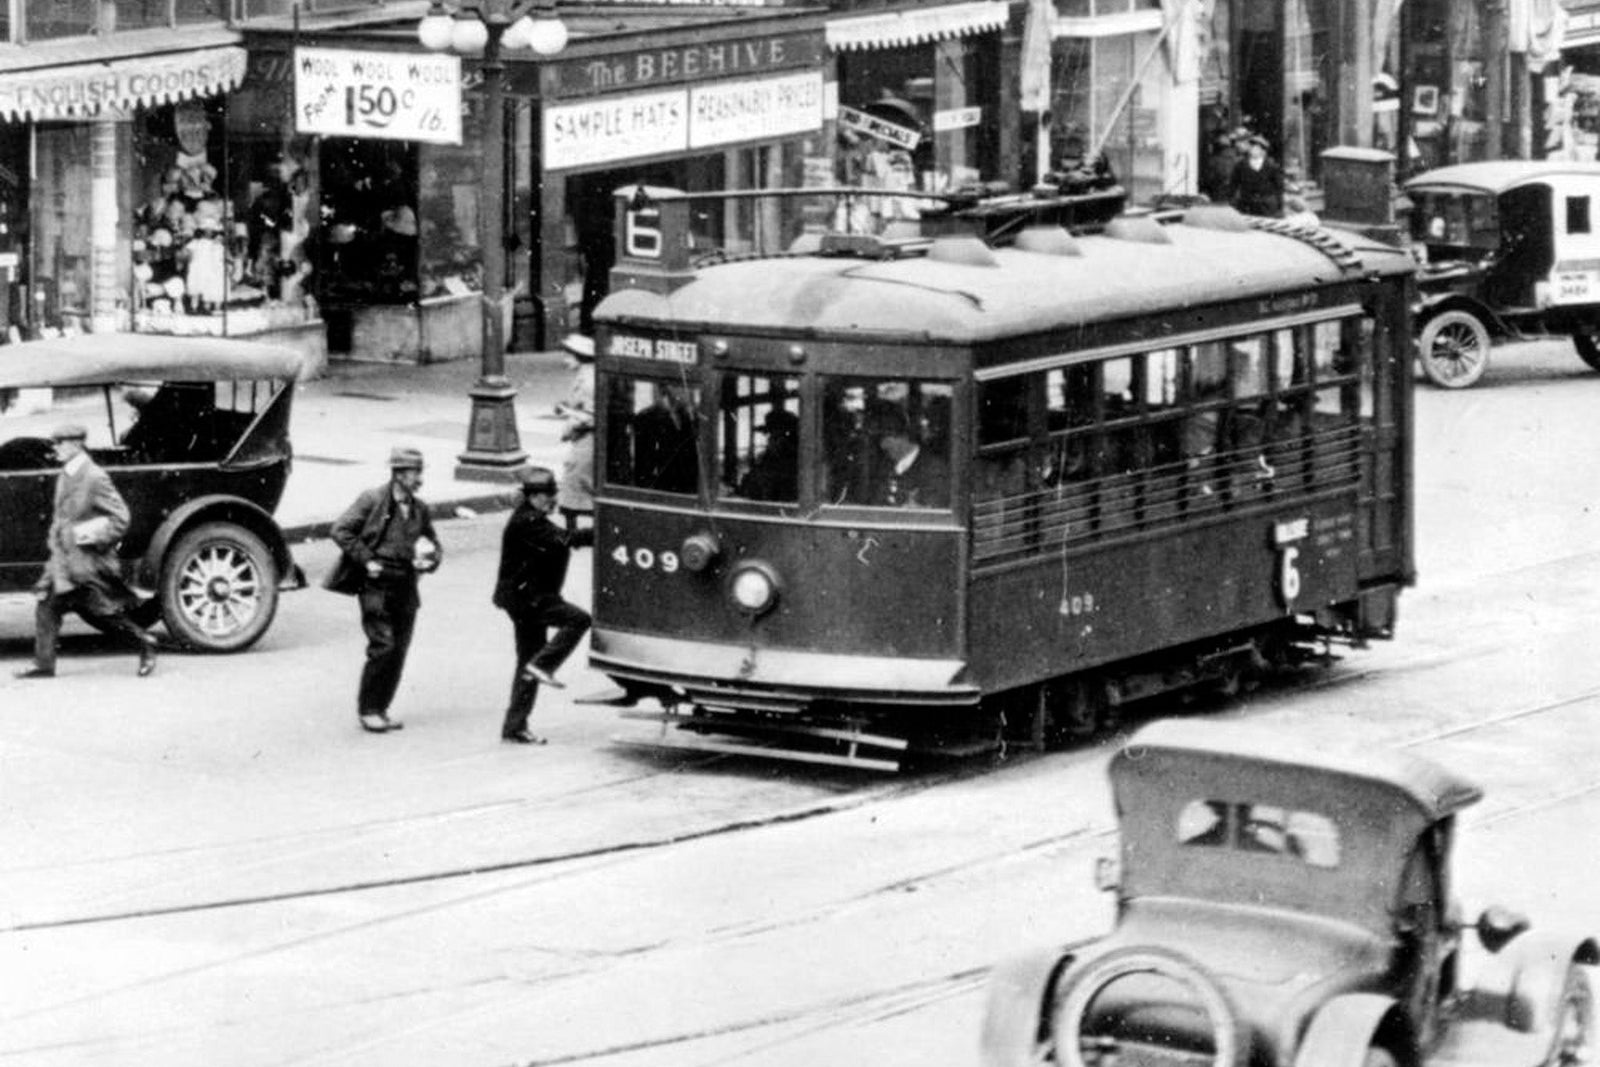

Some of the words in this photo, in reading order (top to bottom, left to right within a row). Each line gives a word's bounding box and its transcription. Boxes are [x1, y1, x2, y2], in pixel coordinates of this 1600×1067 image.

[16, 77, 120, 104] ENGLISH
[129, 64, 211, 97] GOODS
[300, 56, 339, 77] WOOL
[352, 58, 394, 80] WOOL
[407, 61, 452, 83] WOOL
[586, 60, 626, 87] The
[636, 38, 786, 82] BEEHIVE
[553, 107, 623, 143] SAMPLE
[631, 100, 679, 132] HATS
[626, 207, 662, 258] 6
[611, 544, 680, 573] 409
[1281, 546, 1300, 600] 6
